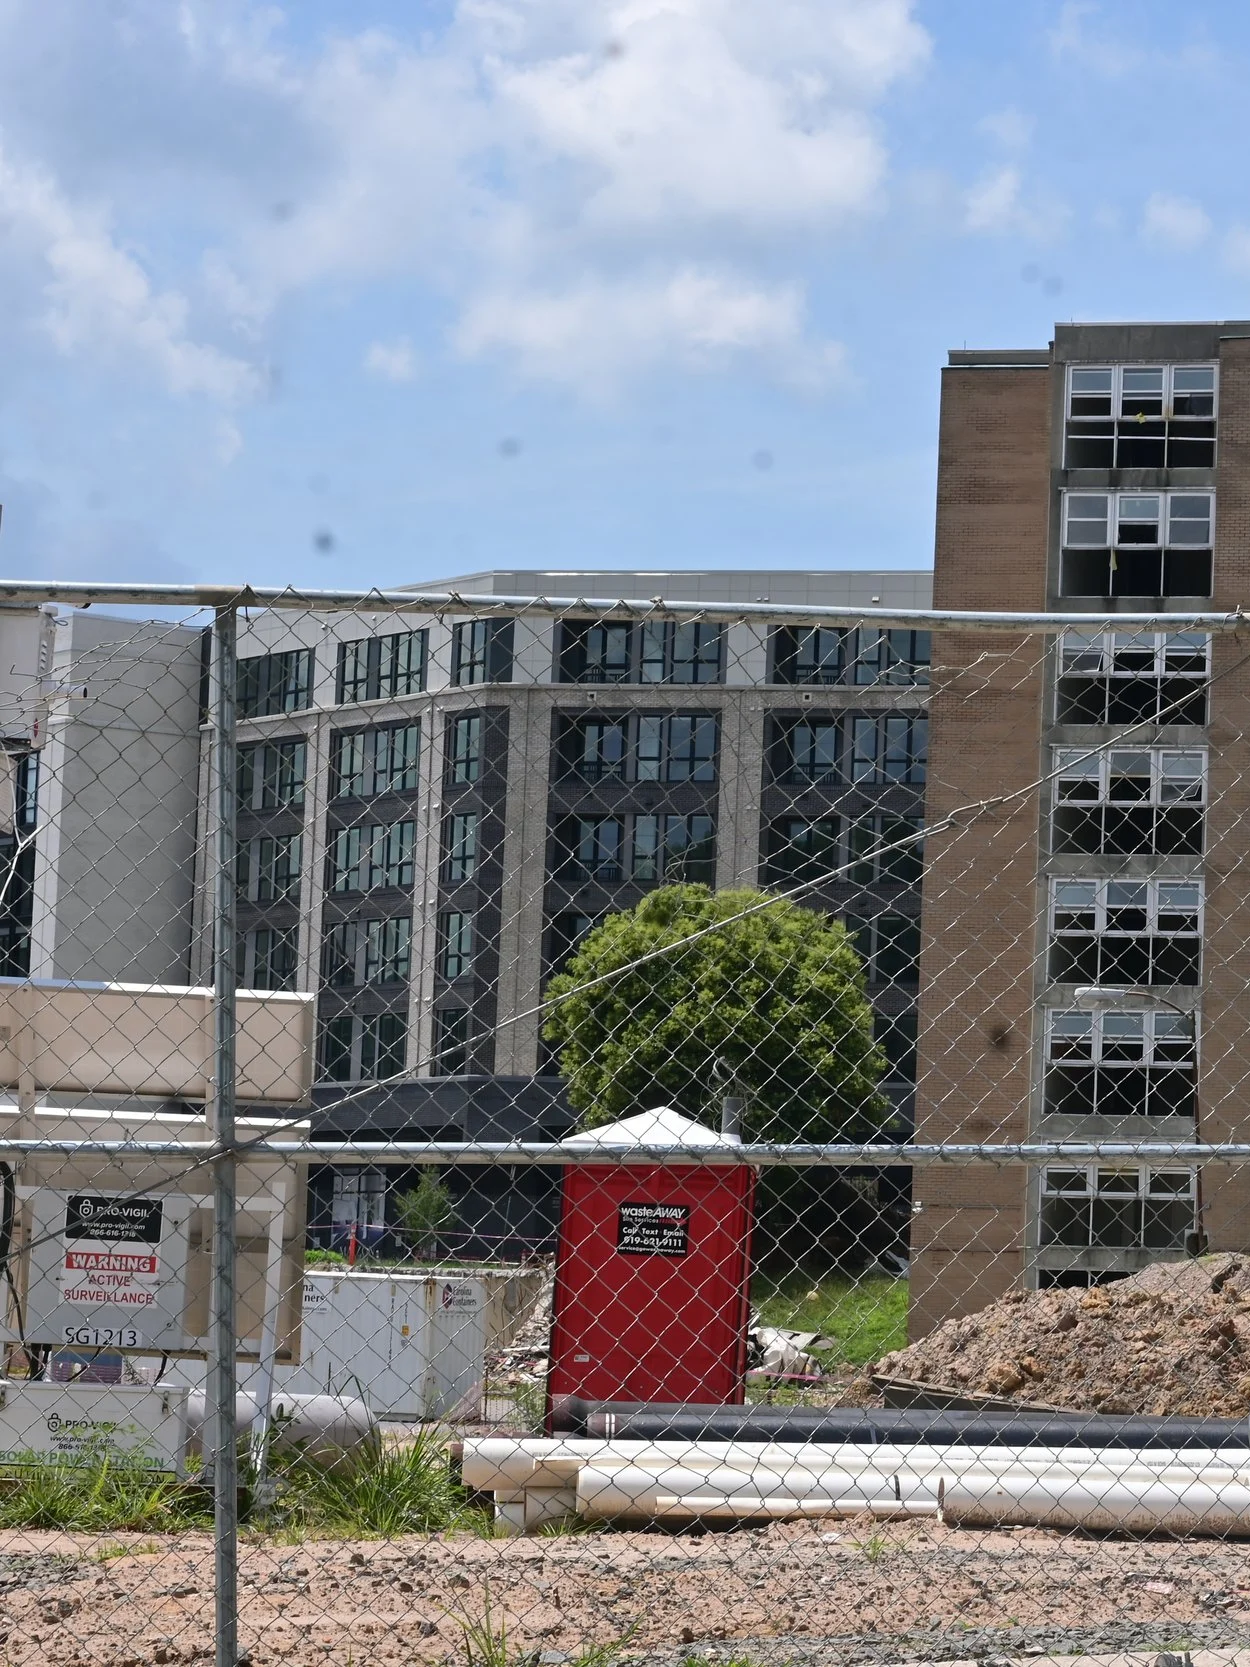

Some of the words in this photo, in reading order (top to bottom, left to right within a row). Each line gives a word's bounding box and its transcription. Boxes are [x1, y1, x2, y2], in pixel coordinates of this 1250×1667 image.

[96, 1206, 148, 1218] PRO-VIGIL
[642, 1227, 659, 1235] Text
[663, 1229, 684, 1237] Email
[623, 1236, 682, 1247] 919-621-9111
[71, 1254, 151, 1272] WARNING
[88, 1274, 131, 1287] ACTIVE
[64, 1289, 153, 1305] SURVEILLANCE
[65, 1326, 138, 1347] SG1213
